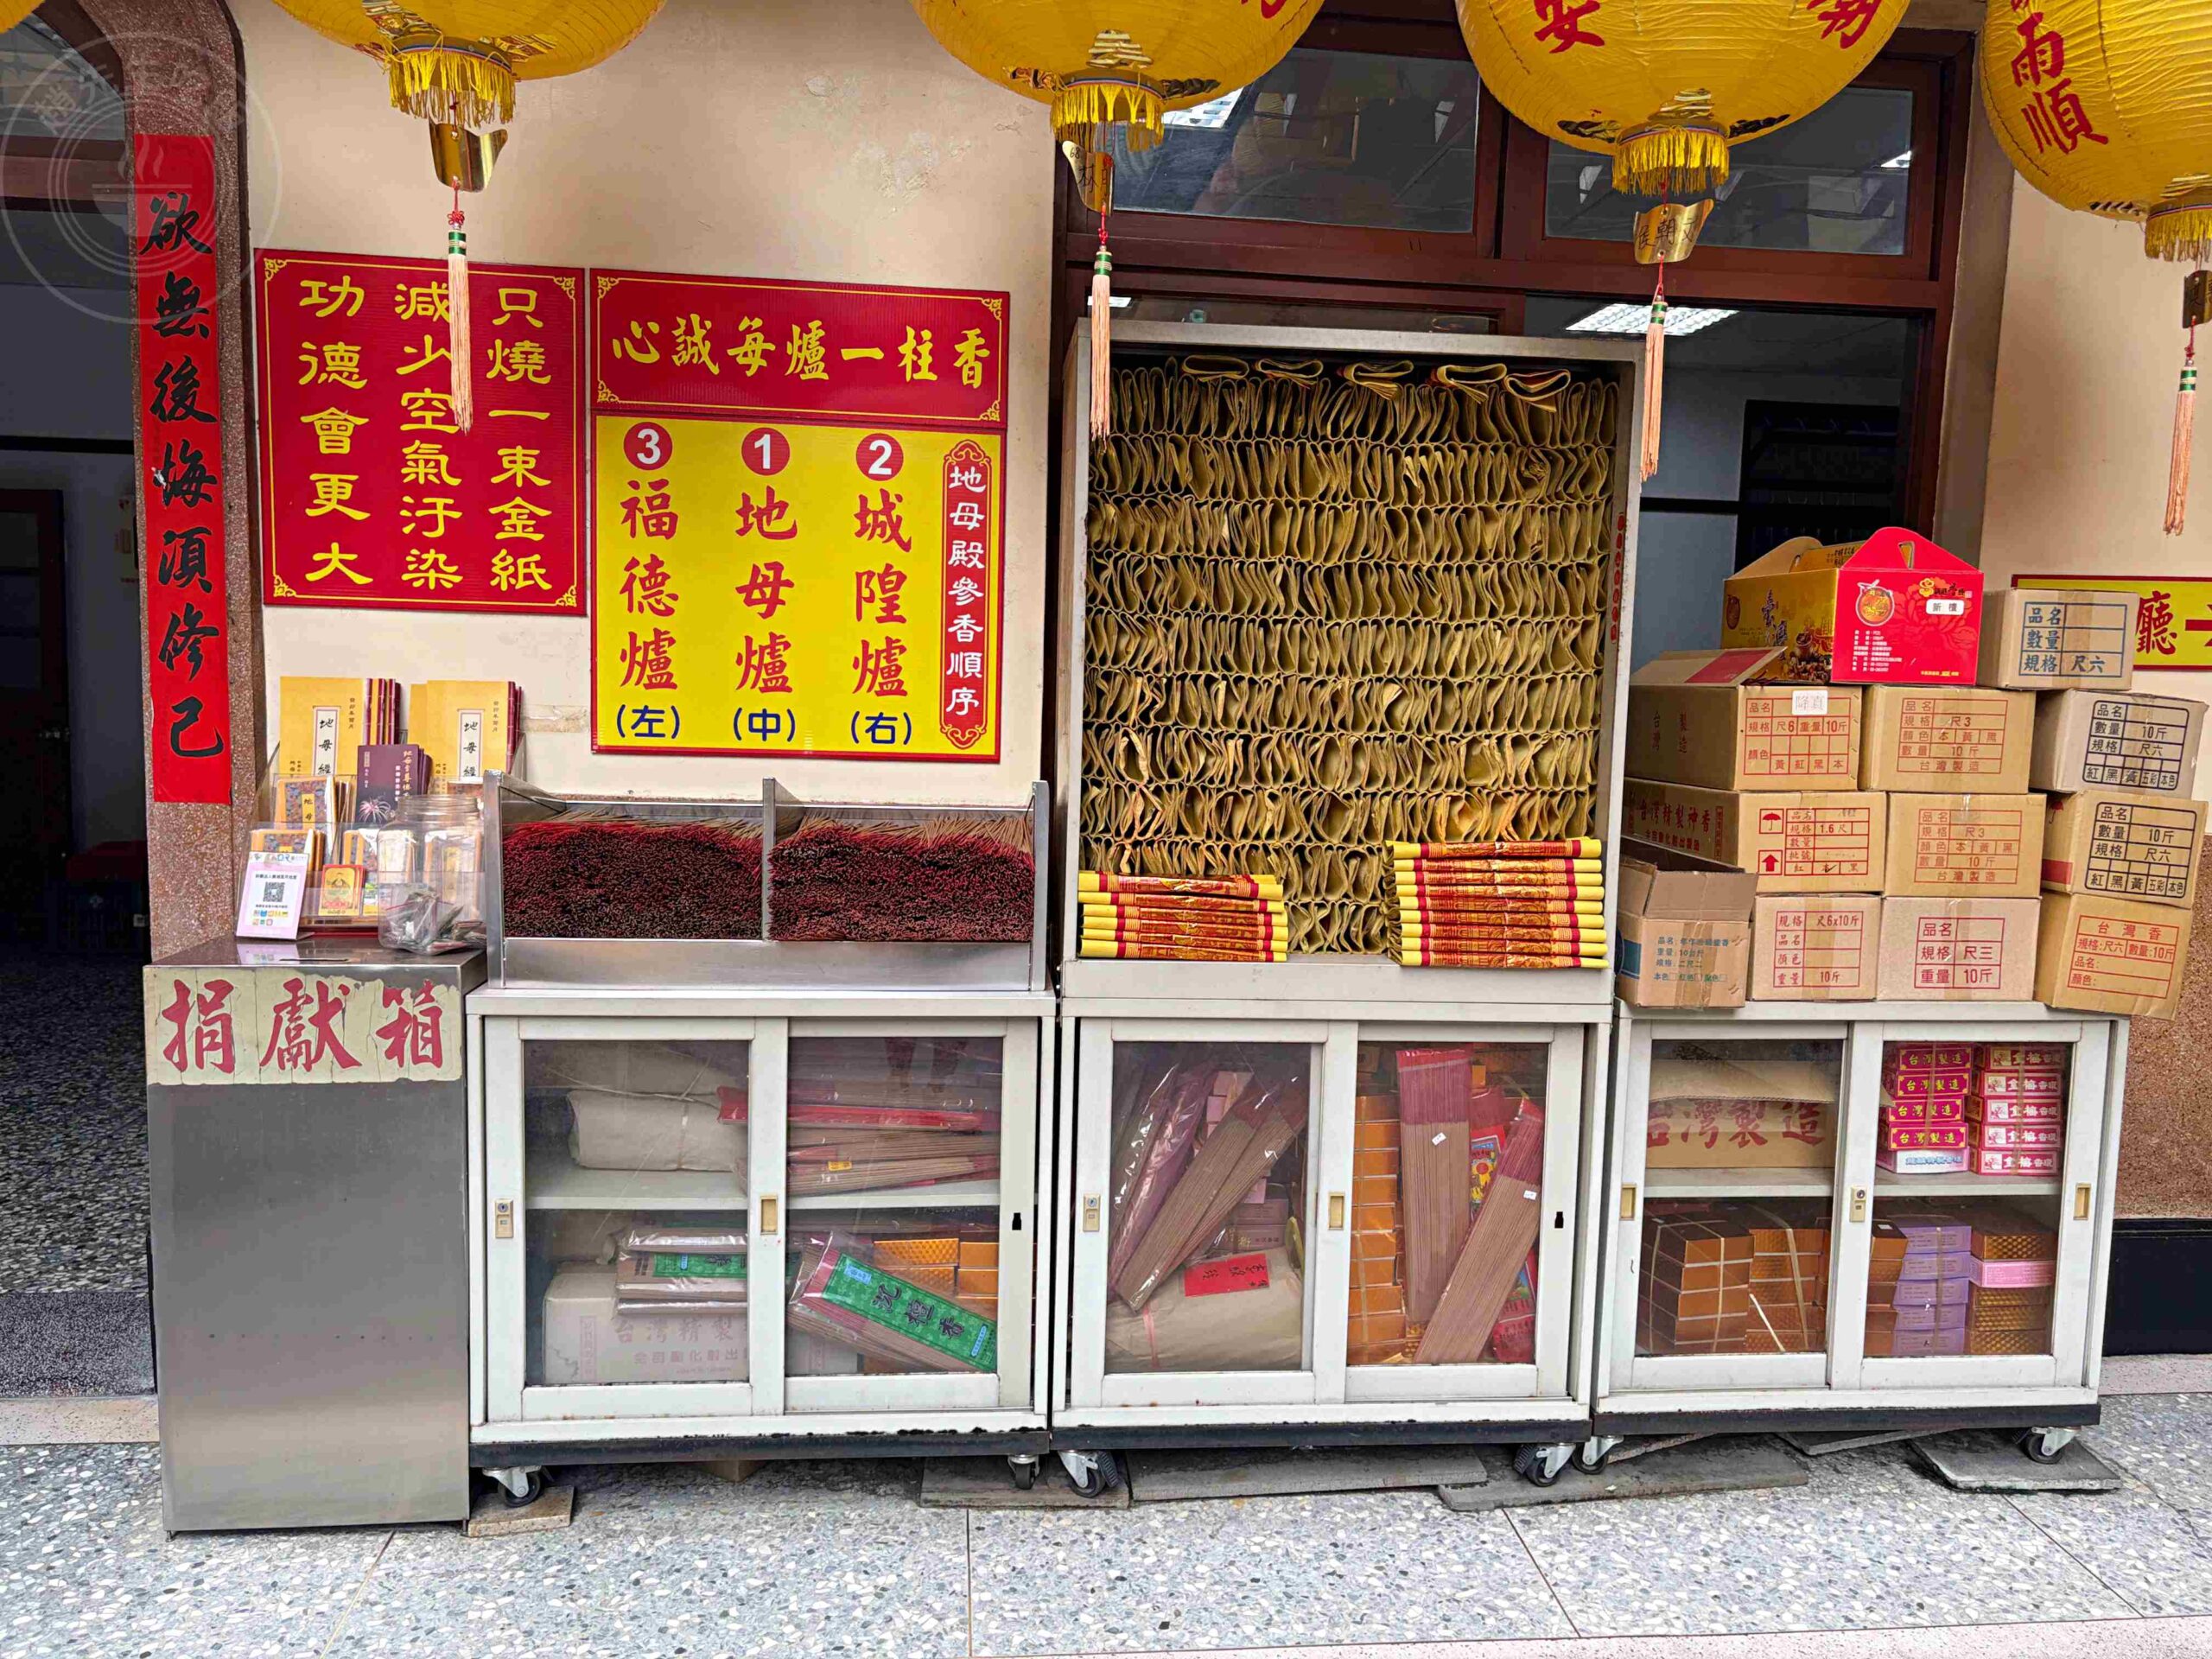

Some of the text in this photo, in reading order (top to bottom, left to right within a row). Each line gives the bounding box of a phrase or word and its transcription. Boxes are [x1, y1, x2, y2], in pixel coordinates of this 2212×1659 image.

[2011, 0, 2108, 155] 雨順
[613, 314, 991, 389] 心誠每爐一柱香
[299, 275, 373, 586] 功德會更大
[486, 287, 553, 591] 只燒一束金紙
[619, 478, 679, 690] 福德爐
[734, 486, 798, 694] 地母爐
[945, 465, 987, 715] 地母殿參香順序
[852, 487, 912, 697] 城隍爐
[2028, 607, 2061, 626] 品名
[2136, 591, 2177, 655] 廳
[2027, 630, 2060, 650] 數量
[2024, 655, 2105, 673] 規格 尺六
[1750, 702, 1770, 712] 品名
[1905, 701, 1931, 711] 品名
[2097, 704, 2122, 718] 品名
[616, 704, 681, 741] (左)
[734, 707, 797, 743] (中)
[851, 711, 912, 747] (右)
[1749, 721, 1847, 733] 規格 尺6 重量 10斤
[1904, 716, 1971, 727] 規格 尺3
[2094, 721, 2167, 740] 數量 10斤
[1952, 747, 1979, 756] 10斤
[2091, 739, 2163, 756] 規格 尺六
[1795, 760, 1804, 770] 紅
[1814, 760, 1824, 769] 黑
[1833, 760, 1843, 769] 本
[1920, 760, 1980, 771] 台灣製造
[2086, 767, 2099, 780] 紅
[2105, 769, 2117, 782] 黑
[2161, 774, 2175, 787] 本色
[1923, 812, 1948, 823] 品名
[2101, 806, 2127, 821] 品名
[1821, 824, 1847, 834] 1.6尺
[1922, 827, 1985, 837] 規格 尺3
[2098, 825, 2174, 843] 數量 10斤
[1956, 842, 1966, 851] 本
[2094, 842, 2171, 862] 規格 尺六
[1969, 857, 1995, 868] 10斤
[1937, 872, 1995, 881] 台灣製造
[2090, 873, 2183, 894] 紅 黑 黃 五彩 本色
[1779, 916, 1802, 927] 規格
[1923, 923, 1952, 937] 品名
[2098, 922, 2161, 940] 台灣香
[1779, 935, 1800, 945] 品名
[1921, 946, 1993, 961] 規格 尺三
[1777, 971, 1840, 985] 重量 10斤
[1921, 969, 1993, 983] 重量 10斤
[162, 977, 443, 1074] 捐獻箱
[1909, 1054, 1962, 1065] 台灣製造
[1907, 1079, 1959, 1090] 台灣製造
[1898, 1104, 1952, 1116] 台灣製造
[1900, 1132, 1955, 1143] 台灣製造
[615, 1317, 747, 1343] 台灣精製
[633, 1348, 747, 1363] 全自動化射出
